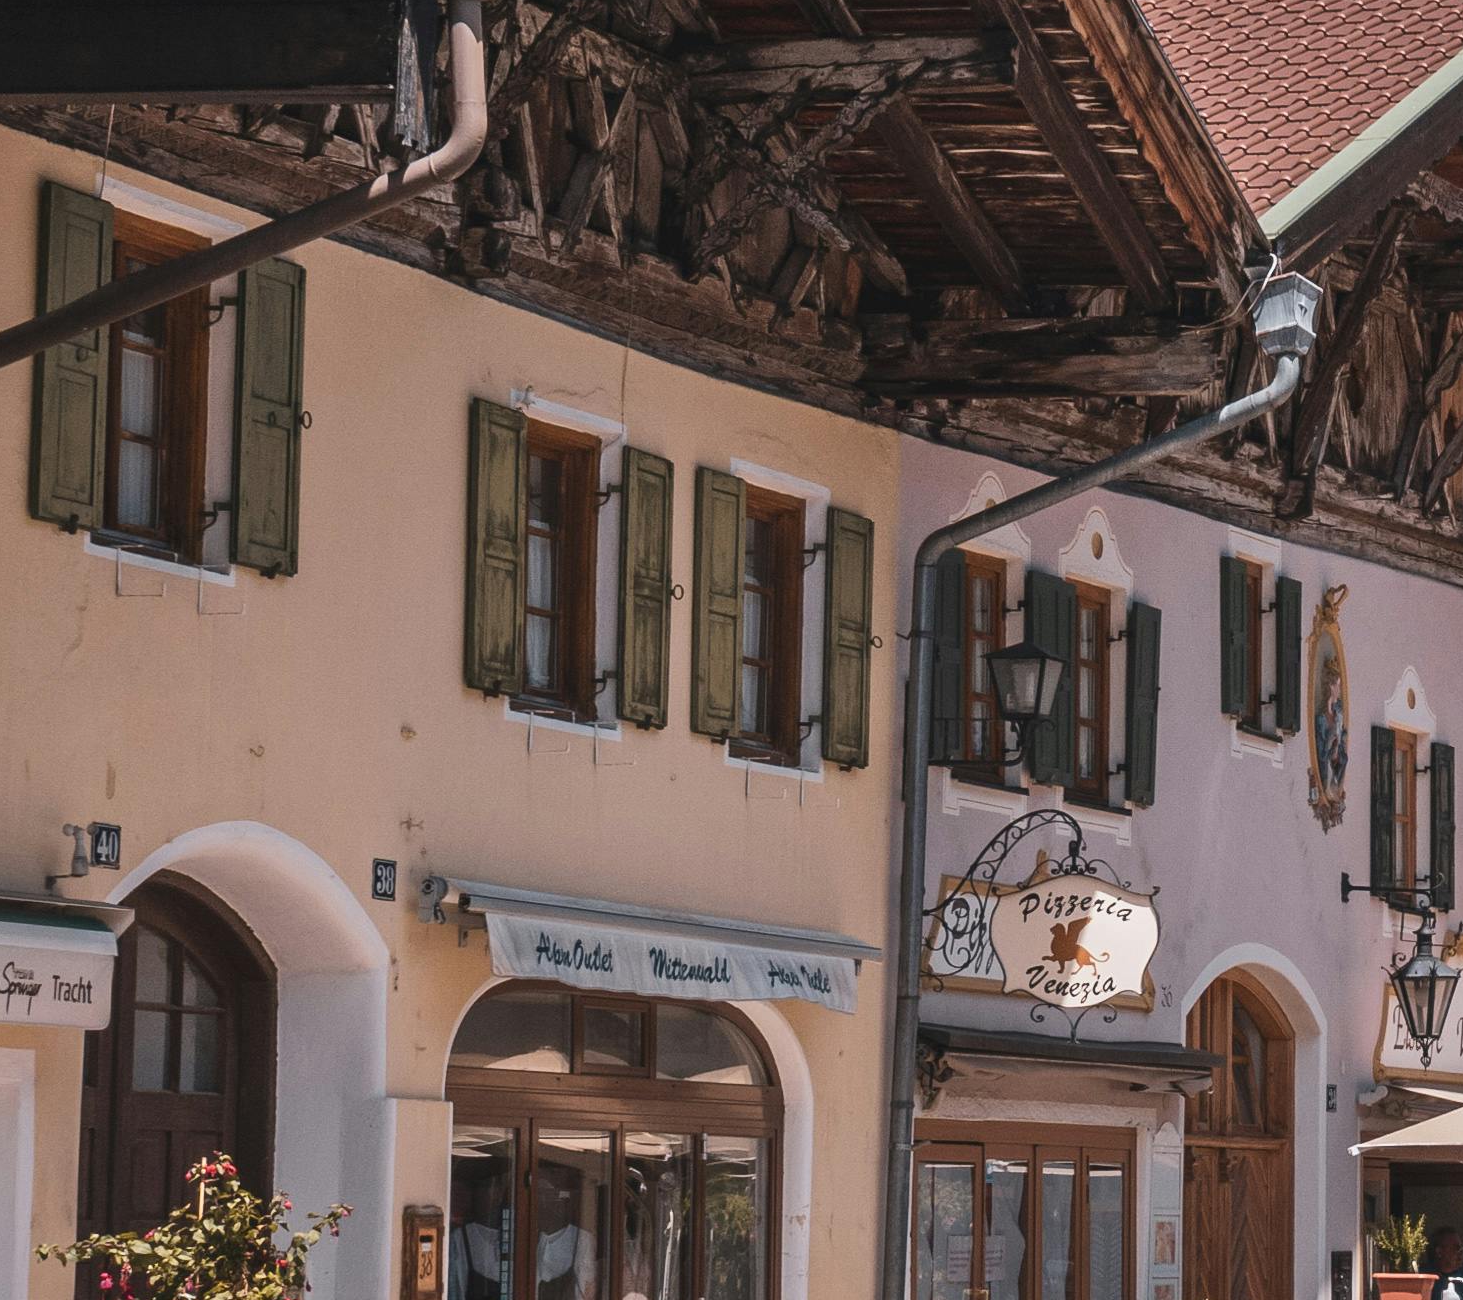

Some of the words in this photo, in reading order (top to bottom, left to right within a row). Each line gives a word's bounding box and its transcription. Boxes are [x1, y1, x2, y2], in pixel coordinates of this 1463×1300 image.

[96, 829, 118, 863] 40
[376, 863, 395, 896] 38
[1018, 891, 1132, 924] Pizzeria
[648, 946, 732, 984] Mittenwald
[51, 974, 93, 1004] Tracht
[1025, 964, 1118, 1004] Venezia
[419, 1250, 434, 1280] 38
